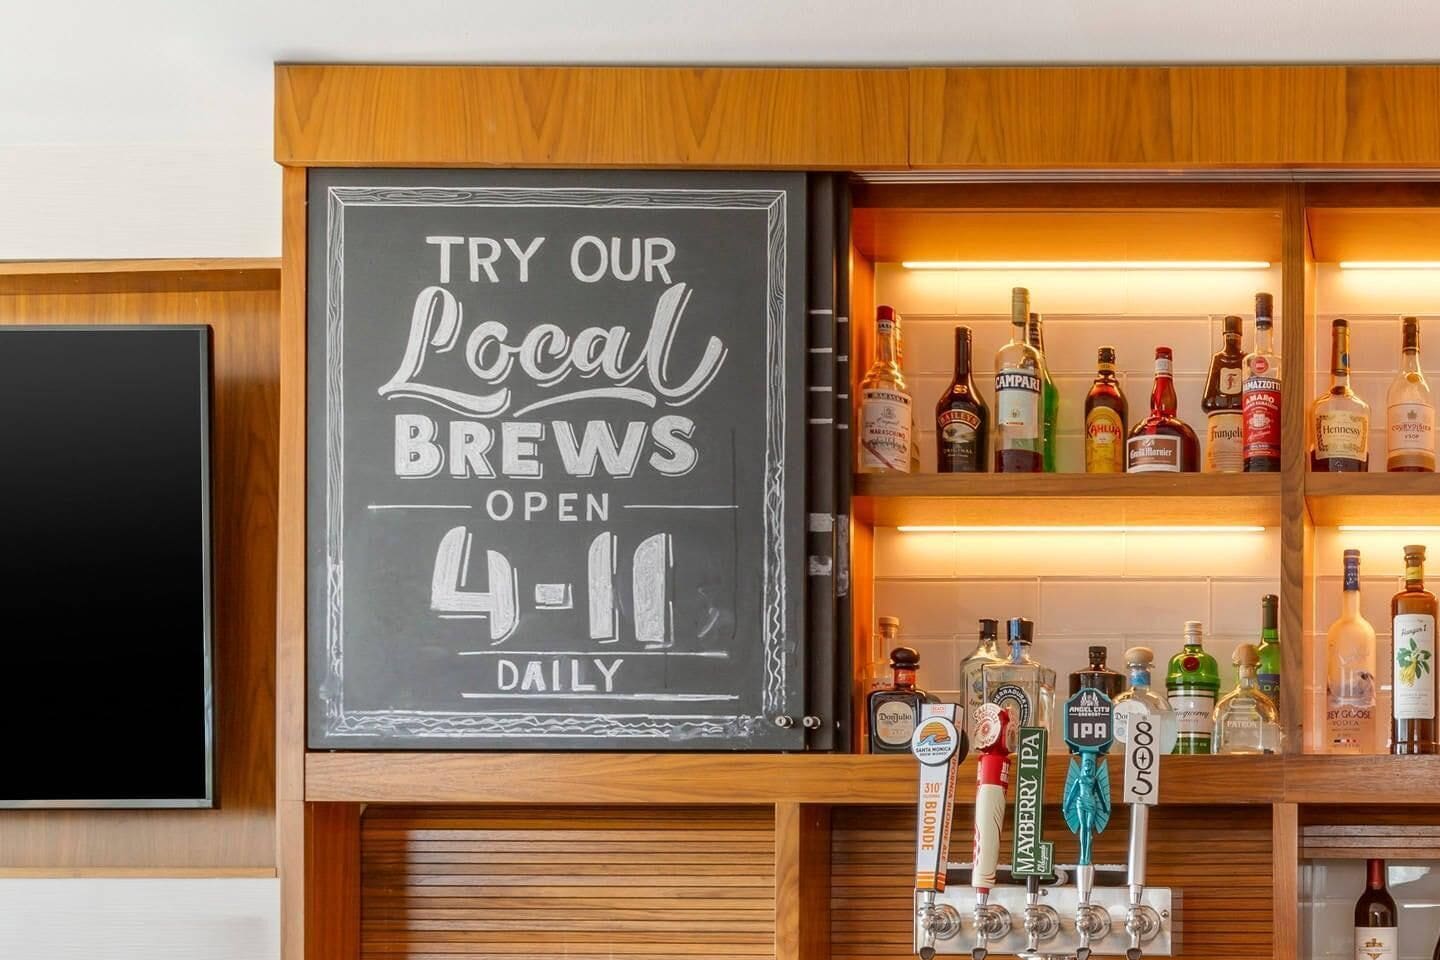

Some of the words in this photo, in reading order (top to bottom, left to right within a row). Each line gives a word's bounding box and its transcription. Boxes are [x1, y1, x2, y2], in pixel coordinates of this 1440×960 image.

[426, 236, 545, 284] TRY
[570, 235, 677, 285] OUR
[378, 282, 728, 417] Local
[995, 372, 1041, 393] CAMPARI
[940, 411, 978, 428] BAILEYS
[1322, 424, 1362, 438] Hennessy
[394, 412, 699, 479] BREWS
[485, 490, 609, 522] OPEN
[430, 525, 674, 650] 4-11
[498, 658, 623, 693] DAILY
[879, 712, 894, 722] Don
[1073, 722, 1107, 739] IPA
[1020, 733, 1040, 769] IPA
[1132, 721, 1154, 796] 805
[924, 782, 940, 793] 310
[922, 801, 937, 851] BLONDE
[1016, 776, 1039, 873] MAYBERRY
